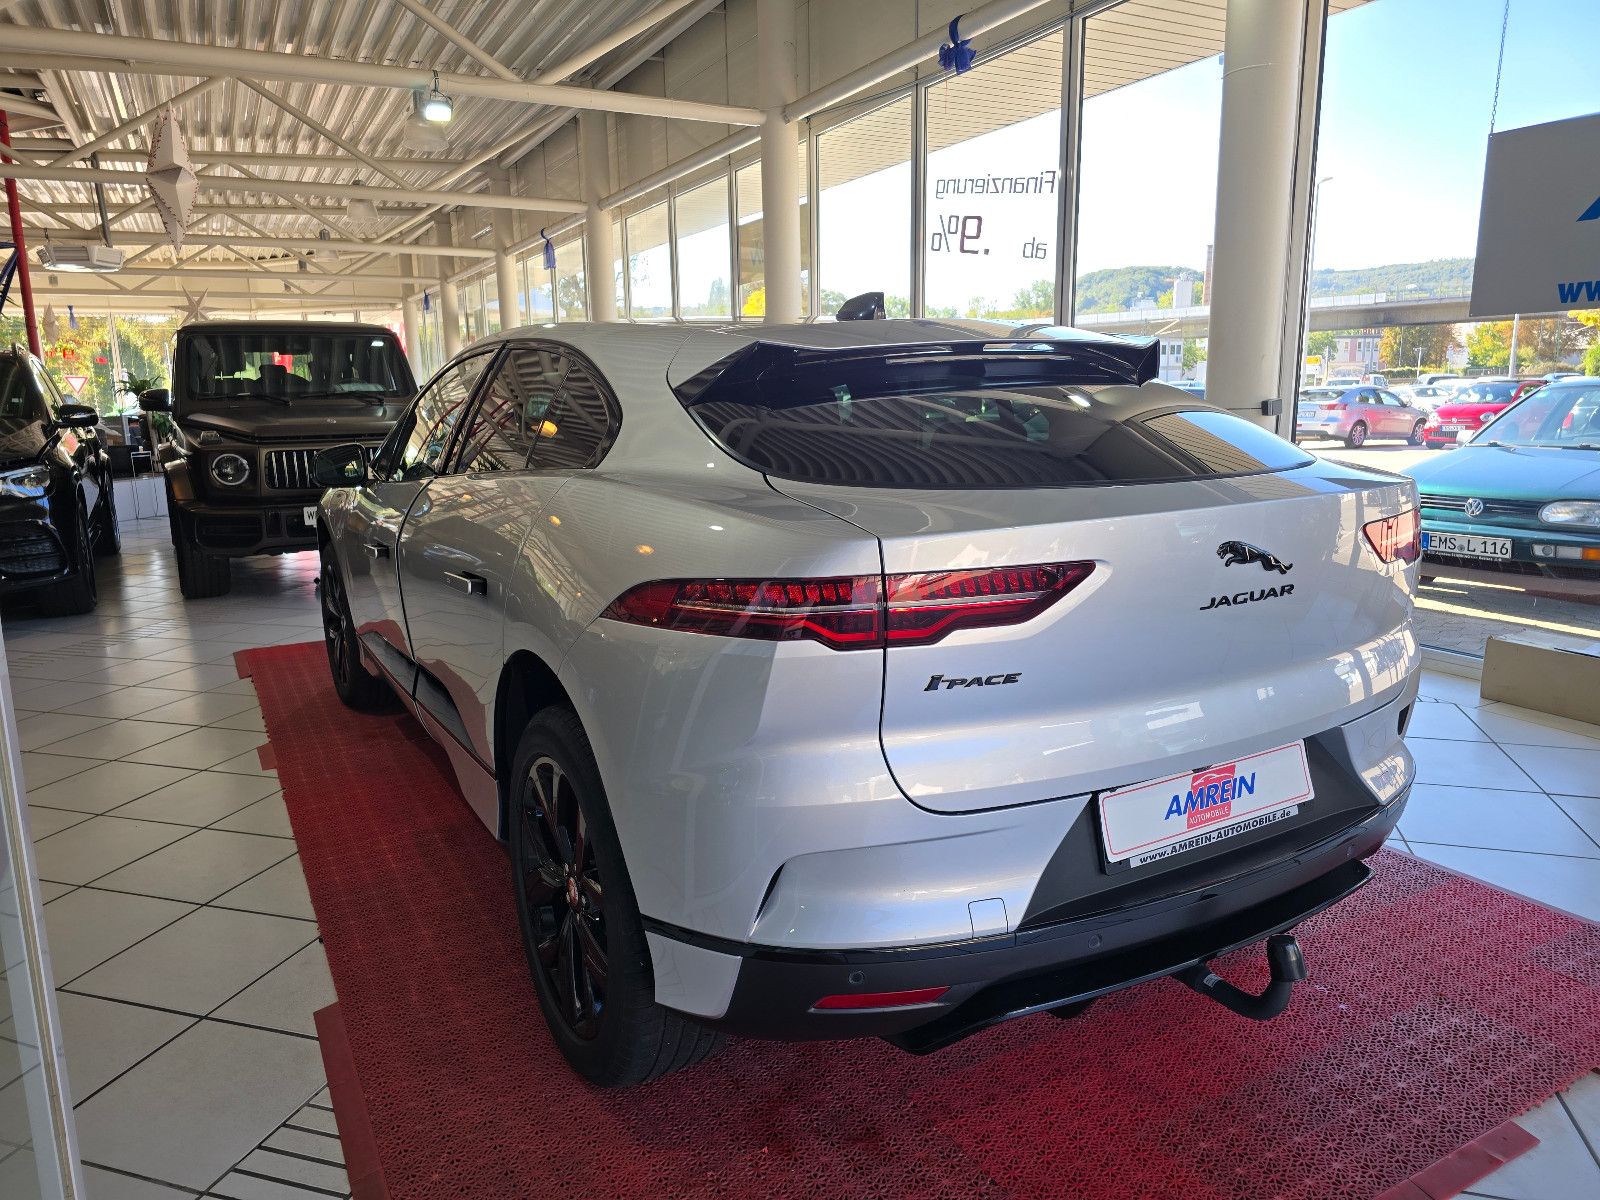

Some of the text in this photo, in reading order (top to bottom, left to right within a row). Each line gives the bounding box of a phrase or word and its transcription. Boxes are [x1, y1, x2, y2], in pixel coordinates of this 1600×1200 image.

[1429, 535, 1457, 551] EMS
[1466, 539, 1476, 553] L
[1480, 541, 1509, 556] 116
[1199, 584, 1295, 611] JAGUAR
[1164, 772, 1257, 821] AMREIN
[1189, 806, 1230, 825] AUTOMOBILE
[1139, 809, 1292, 865] www.AMREIN-AUTOMOBILE.de
